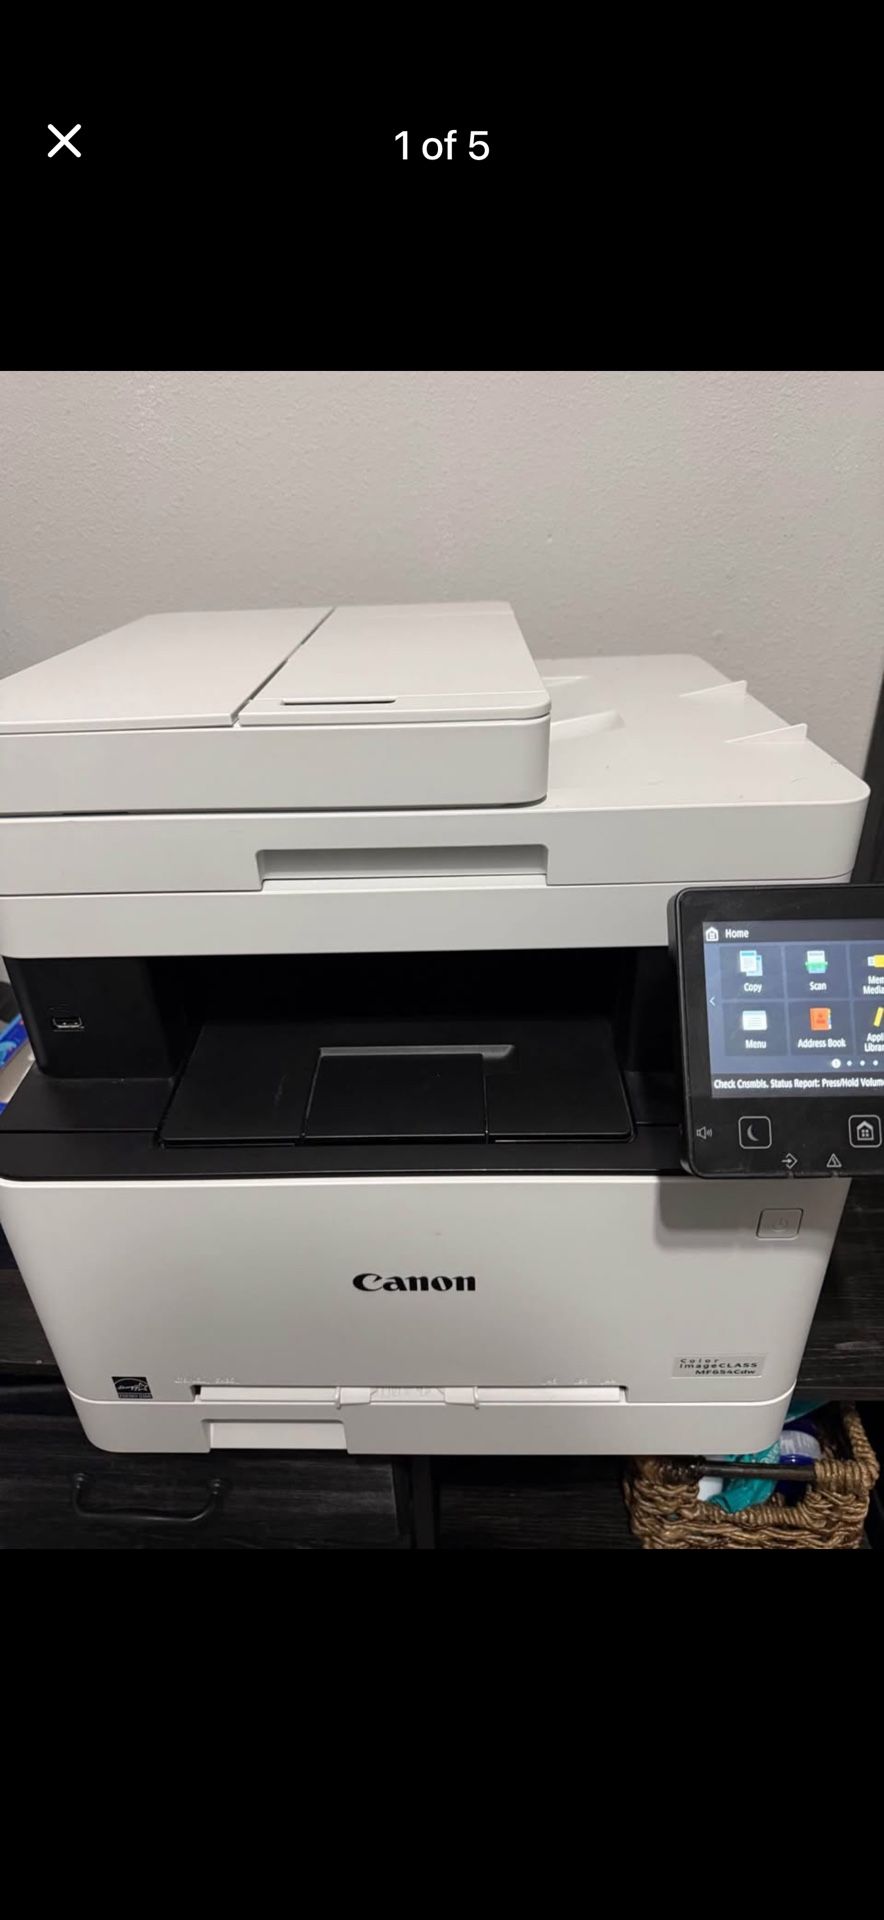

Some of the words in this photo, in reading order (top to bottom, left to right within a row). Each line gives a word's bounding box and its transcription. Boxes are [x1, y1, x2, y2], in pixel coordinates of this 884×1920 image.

[725, 928, 749, 939] Home
[743, 982, 762, 993] Copy
[809, 981, 827, 991] Scan
[745, 1039, 767, 1049] Menu
[798, 1038, 826, 1049] Address
[827, 1038, 846, 1048] Book
[714, 1079, 736, 1089] Check
[737, 1079, 769, 1089] Cnsmbls.
[770, 1079, 793, 1088] Status
[794, 1078, 820, 1089] Report:
[821, 1077, 859, 1088] Press/Hold
[352, 1273, 476, 1292] Canon
